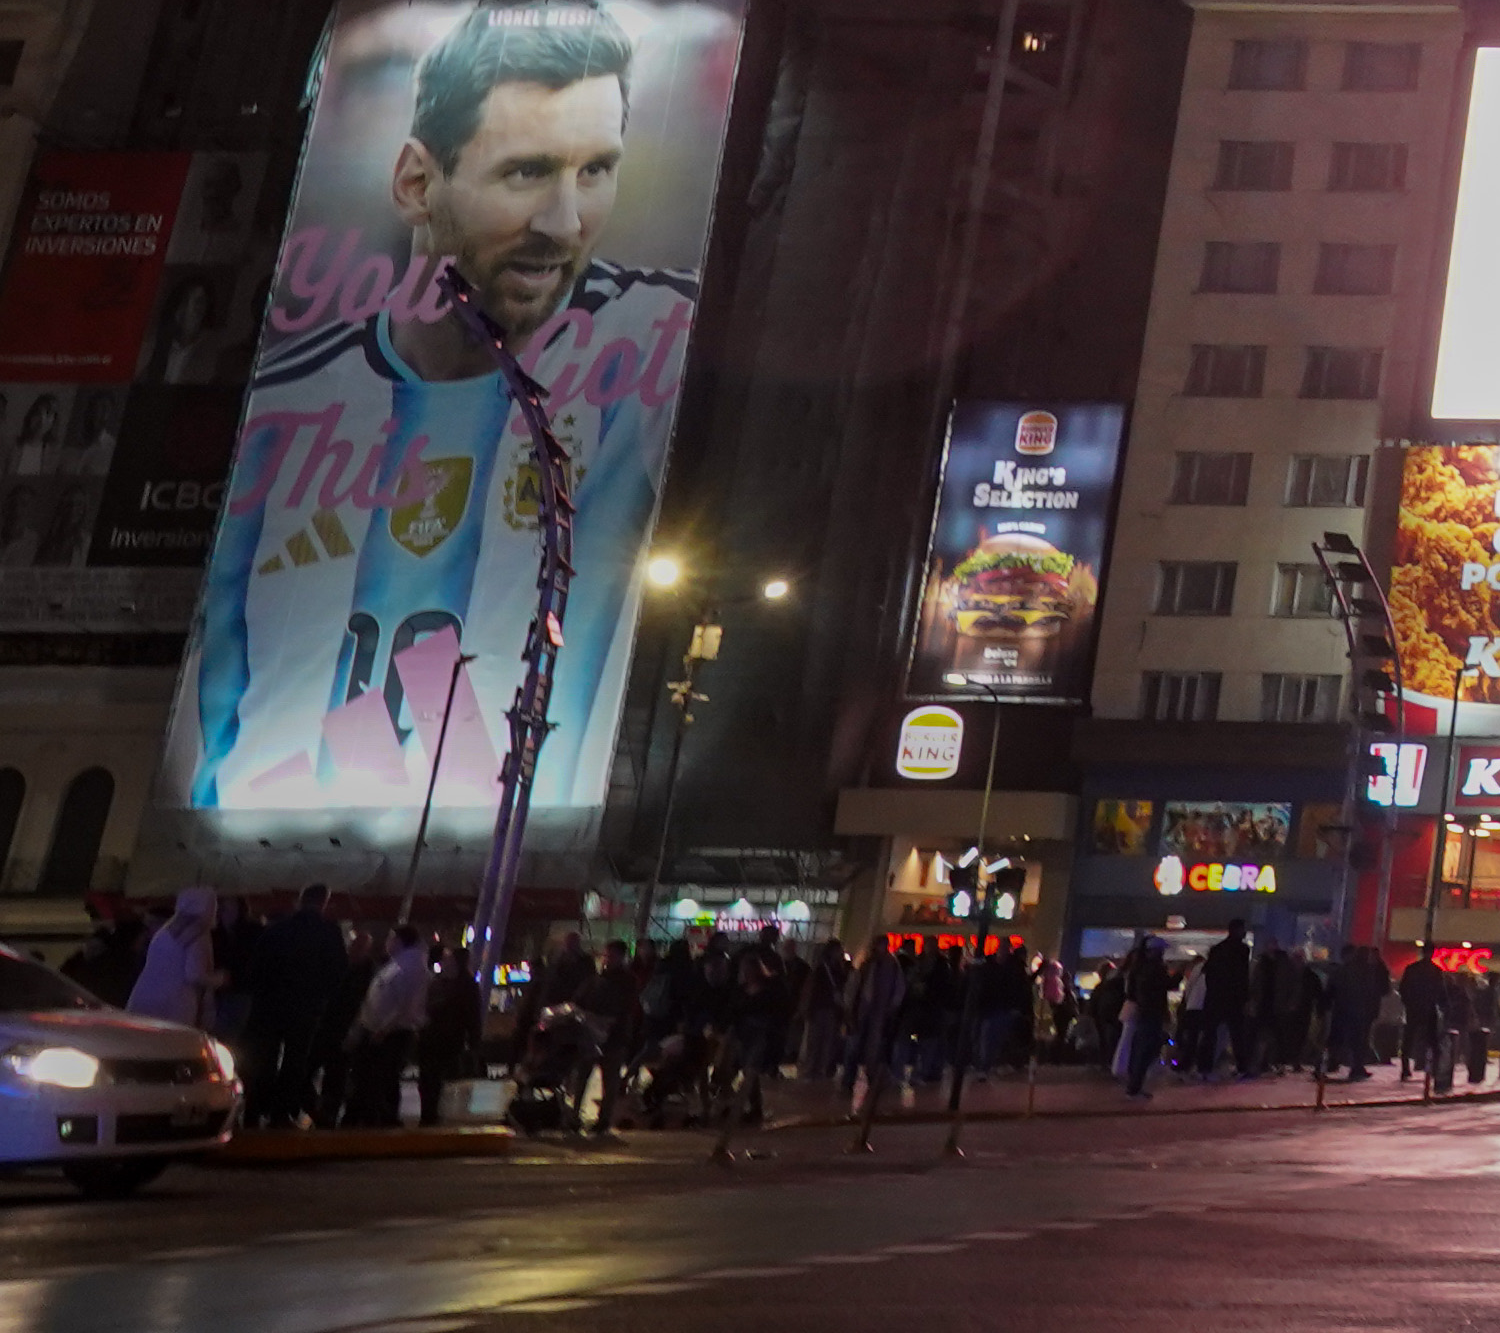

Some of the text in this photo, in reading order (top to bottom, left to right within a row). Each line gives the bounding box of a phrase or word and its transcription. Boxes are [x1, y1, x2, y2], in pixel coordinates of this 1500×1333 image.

[37, 191, 111, 212] SOMOS
[30, 213, 163, 234] EXPERTOS EN
[24, 234, 157, 256] INVERSIONES
[270, 226, 458, 332] You
[511, 301, 692, 434] Got
[230, 401, 449, 517] This
[140, 480, 223, 511] ICBC
[902, 745, 955, 763] KING
[1188, 862, 1277, 893] CEBRA
[1431, 947, 1493, 974] KFC
